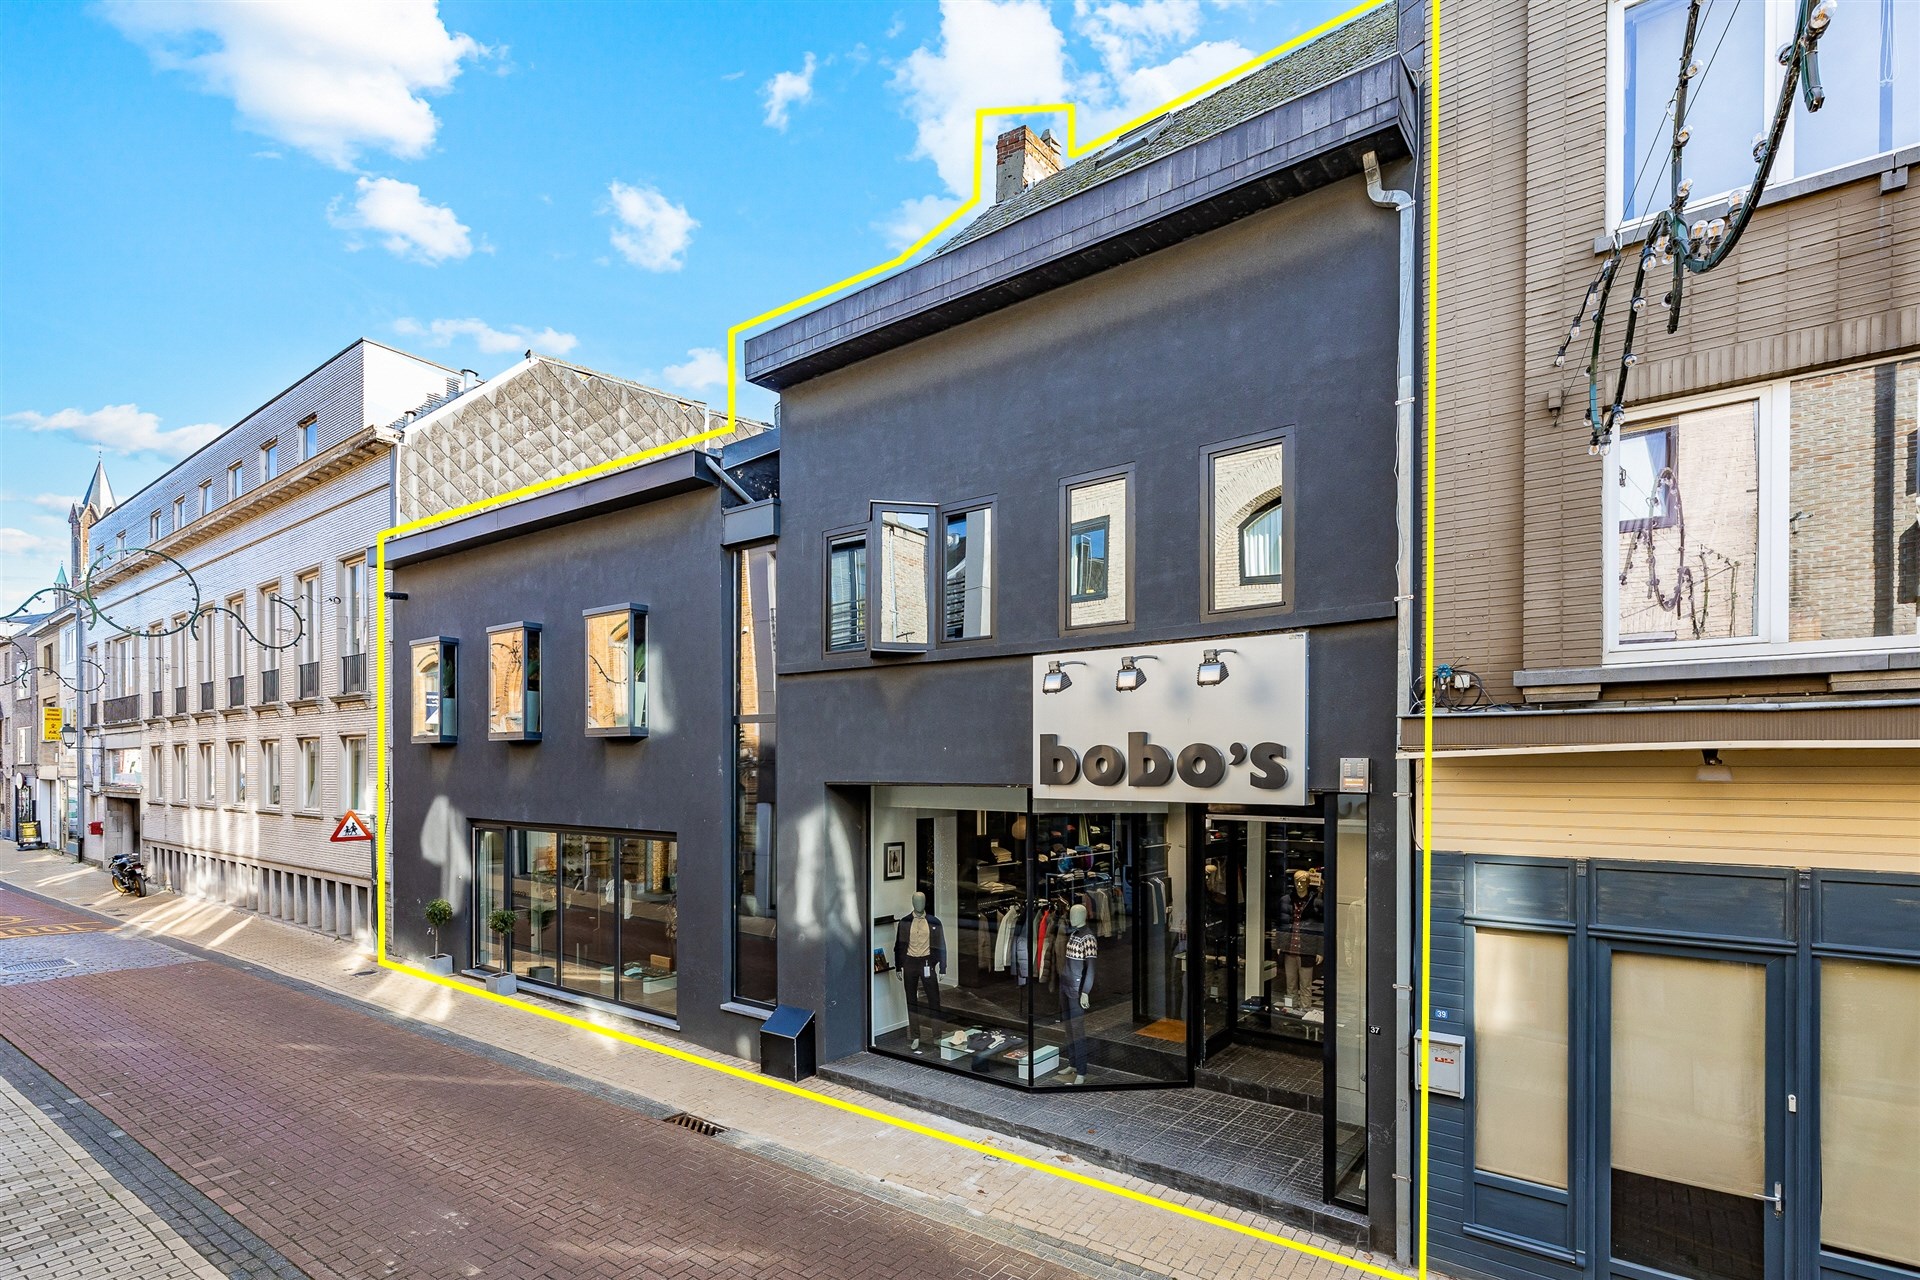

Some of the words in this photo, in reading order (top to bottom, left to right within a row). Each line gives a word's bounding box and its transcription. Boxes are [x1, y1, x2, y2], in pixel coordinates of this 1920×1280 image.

[1040, 732, 1288, 789] bobo's
[1437, 1010, 1446, 1018] 39
[1370, 1026, 1380, 1034] 37
